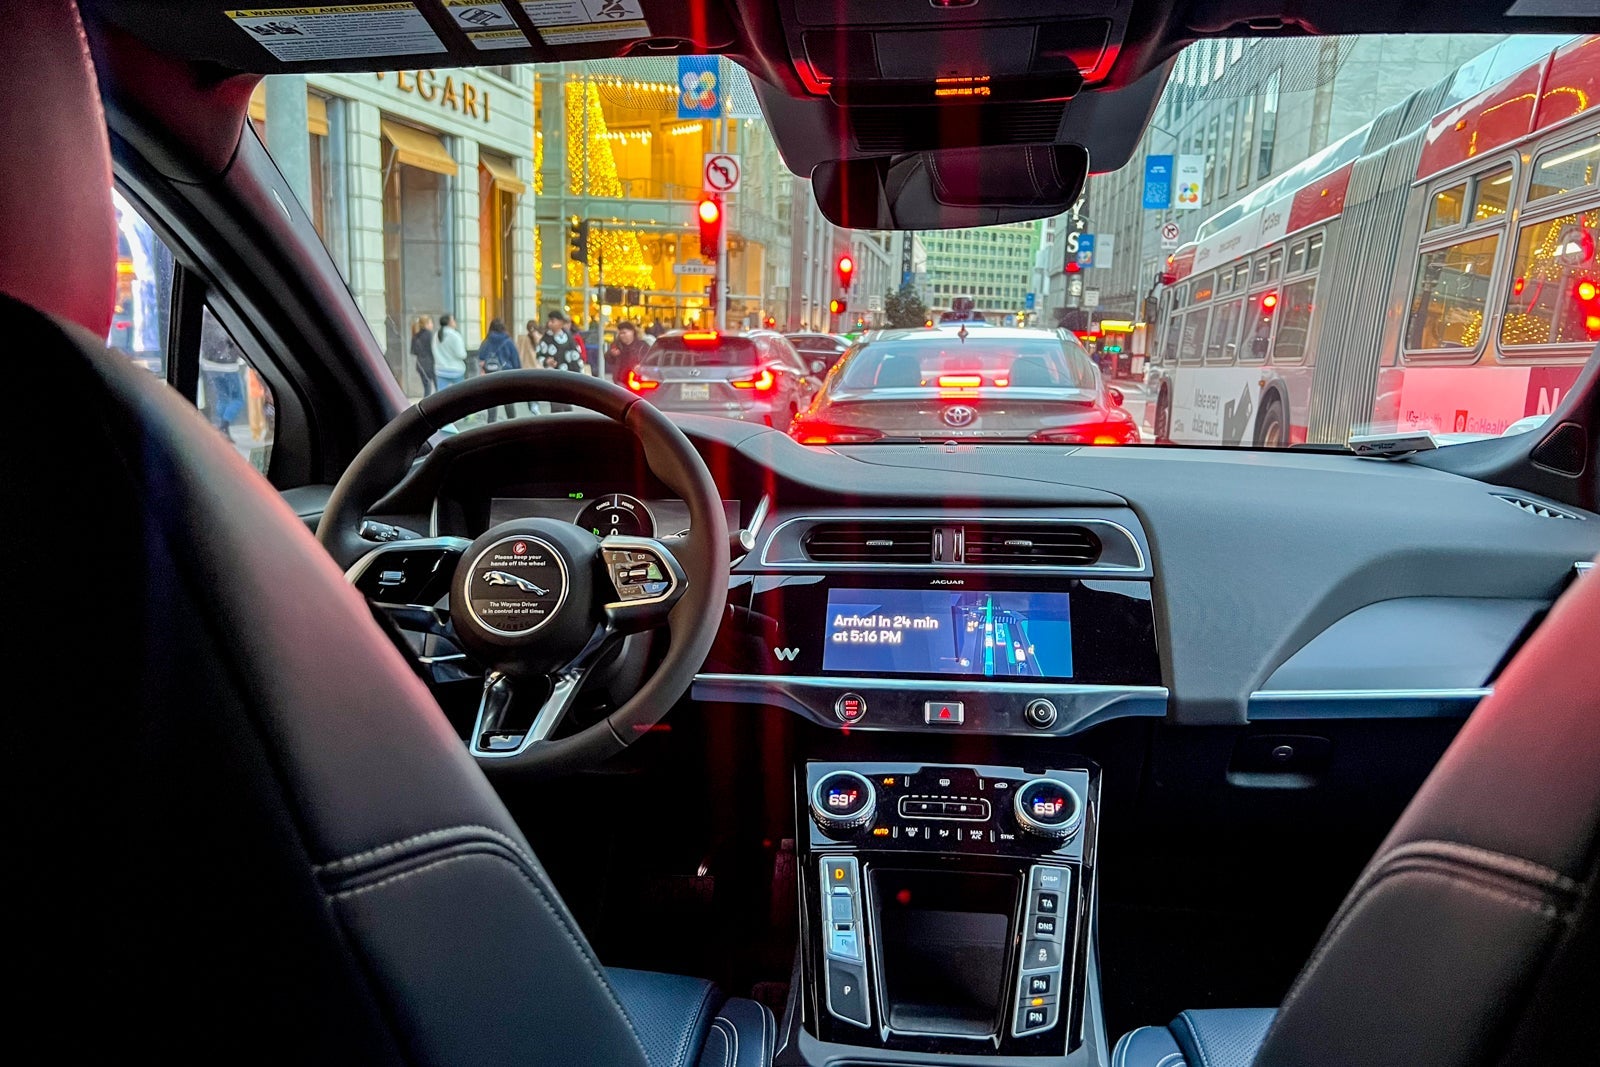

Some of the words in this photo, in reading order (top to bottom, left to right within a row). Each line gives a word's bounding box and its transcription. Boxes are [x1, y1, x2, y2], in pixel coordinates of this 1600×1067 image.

[251, 8, 307, 16] WARNING
[611, 514, 619, 524] D
[833, 615, 876, 627] Arrival
[878, 616, 891, 627] in
[893, 616, 912, 629] 24
[913, 616, 939, 629] min
[832, 631, 849, 642] at
[850, 630, 877, 642] 5:16
[880, 631, 902, 643] PM
[873, 828, 889, 836] AUTO
[835, 868, 845, 880] D
[1041, 898, 1053, 908] TA
[1038, 922, 1053, 931] DNS
[1033, 979, 1046, 990] PN
[844, 985, 851, 995] P
[1030, 1012, 1043, 1022] PN
